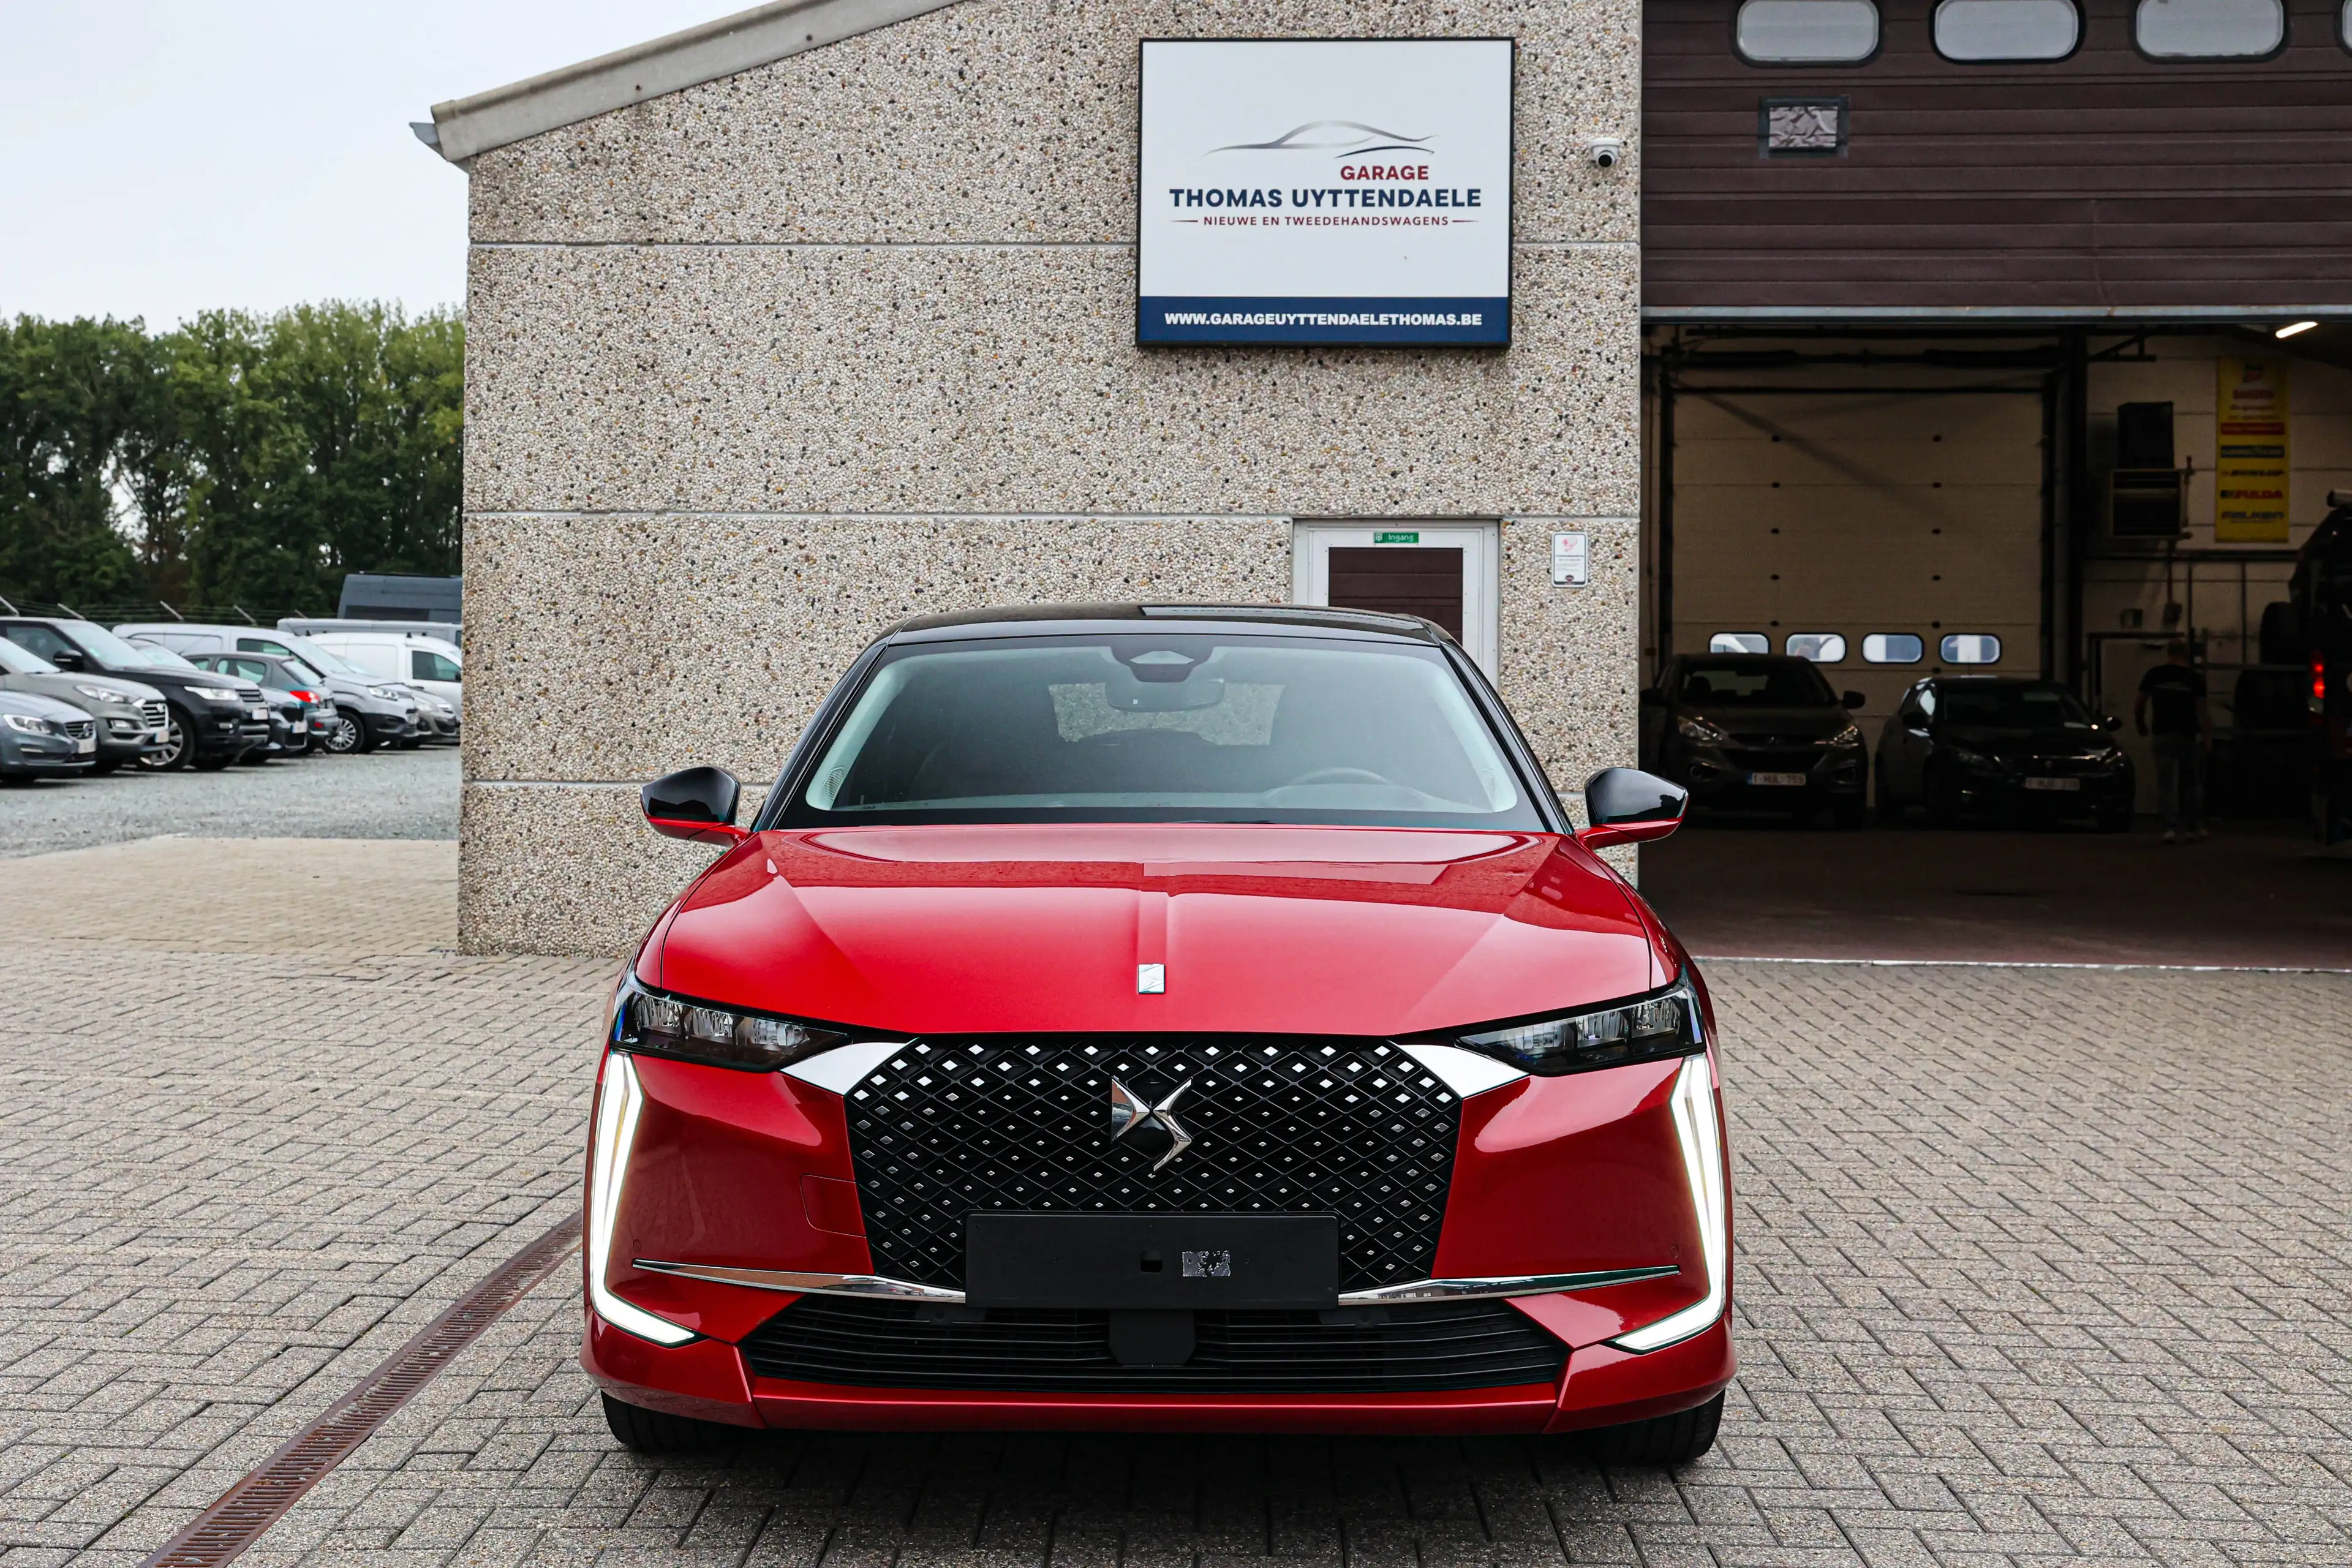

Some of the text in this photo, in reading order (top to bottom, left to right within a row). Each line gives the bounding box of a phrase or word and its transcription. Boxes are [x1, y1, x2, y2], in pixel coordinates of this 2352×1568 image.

[1340, 165, 1429, 181] GARAGE
[1169, 188, 1482, 208] THOMAS UYTTENDAELE
[1204, 216, 1449, 226] NIEUWE EN TWEEDEHANDSWAGENS
[1164, 313, 1482, 326] WWW.GARAGEUYTTENDAELETHOMAS.BE
[1387, 533, 1414, 543] Ingang
